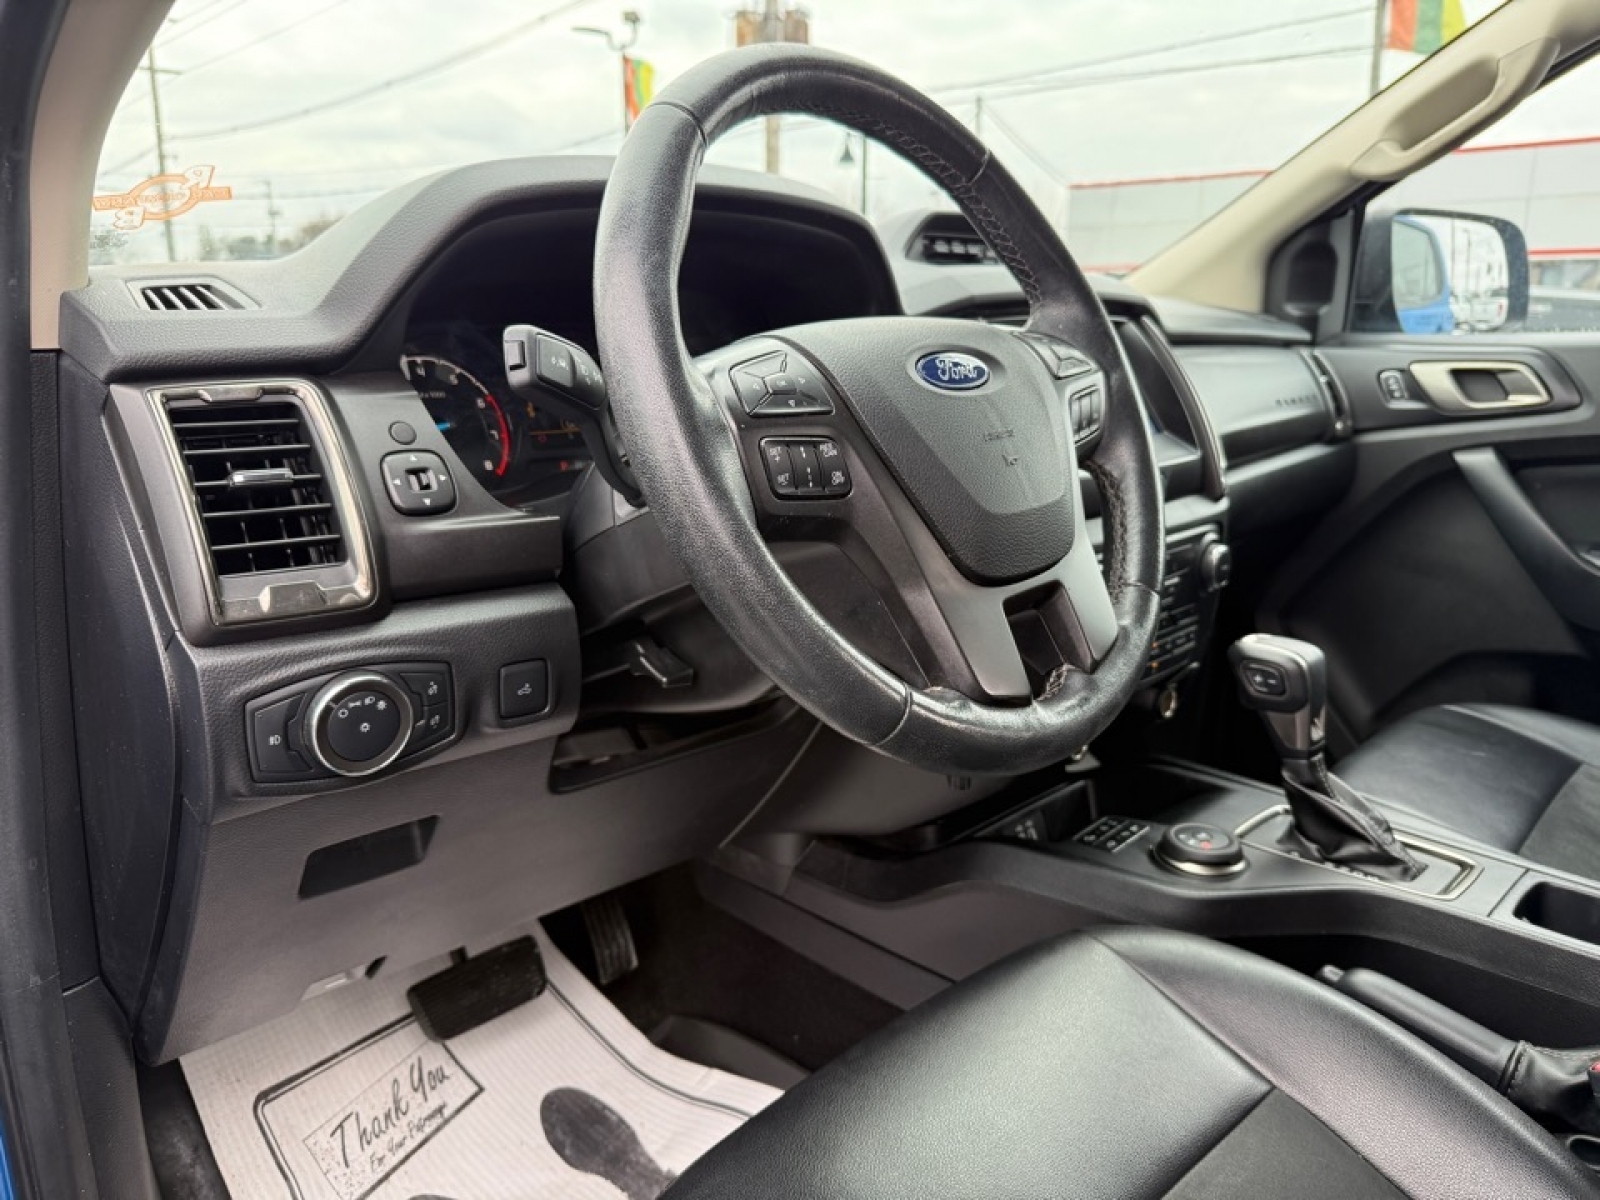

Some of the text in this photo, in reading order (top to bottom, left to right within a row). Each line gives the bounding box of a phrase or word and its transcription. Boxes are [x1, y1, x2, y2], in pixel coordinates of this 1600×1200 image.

[934, 358, 977, 381] Ford
[330, 1055, 451, 1169] Thank You
